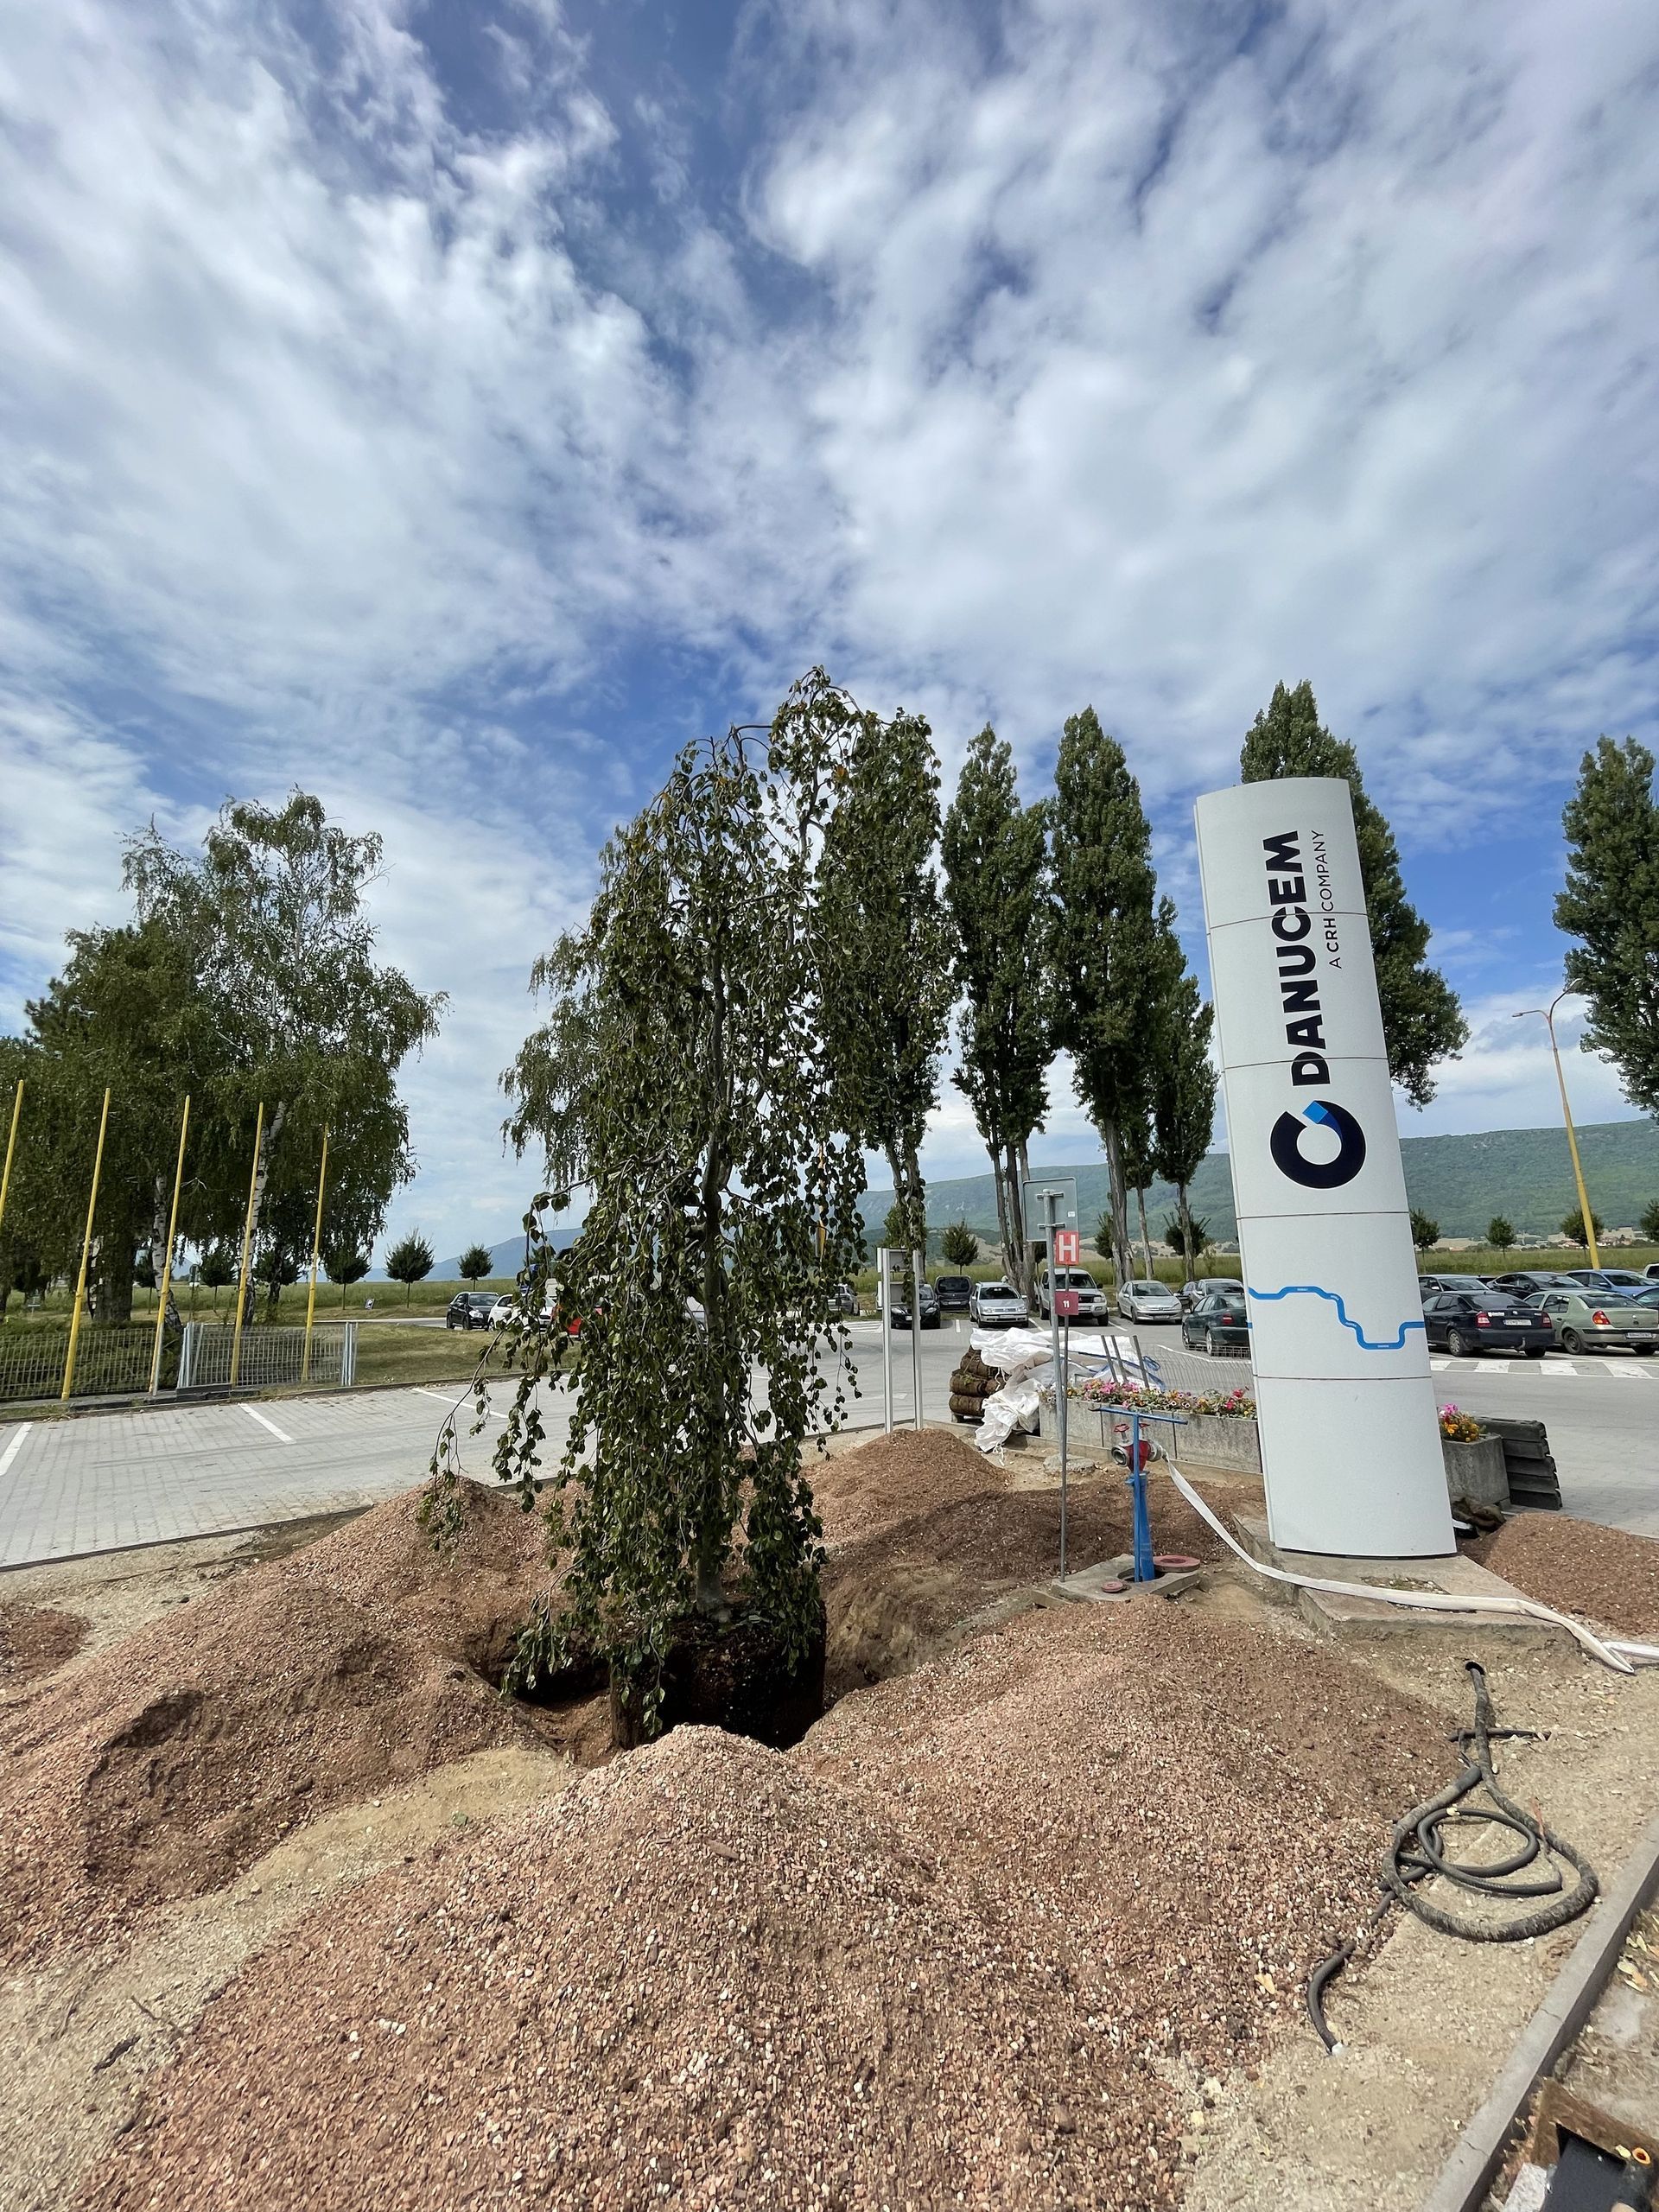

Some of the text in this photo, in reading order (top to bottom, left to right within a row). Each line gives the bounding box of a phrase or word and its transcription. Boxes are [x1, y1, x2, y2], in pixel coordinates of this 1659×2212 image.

[1312, 830, 1342, 969] A CRH COMPANY
[1262, 830, 1331, 1086] DANUCEM
[1058, 1234, 1076, 1262] H
[1063, 1300, 1070, 1308] 11
